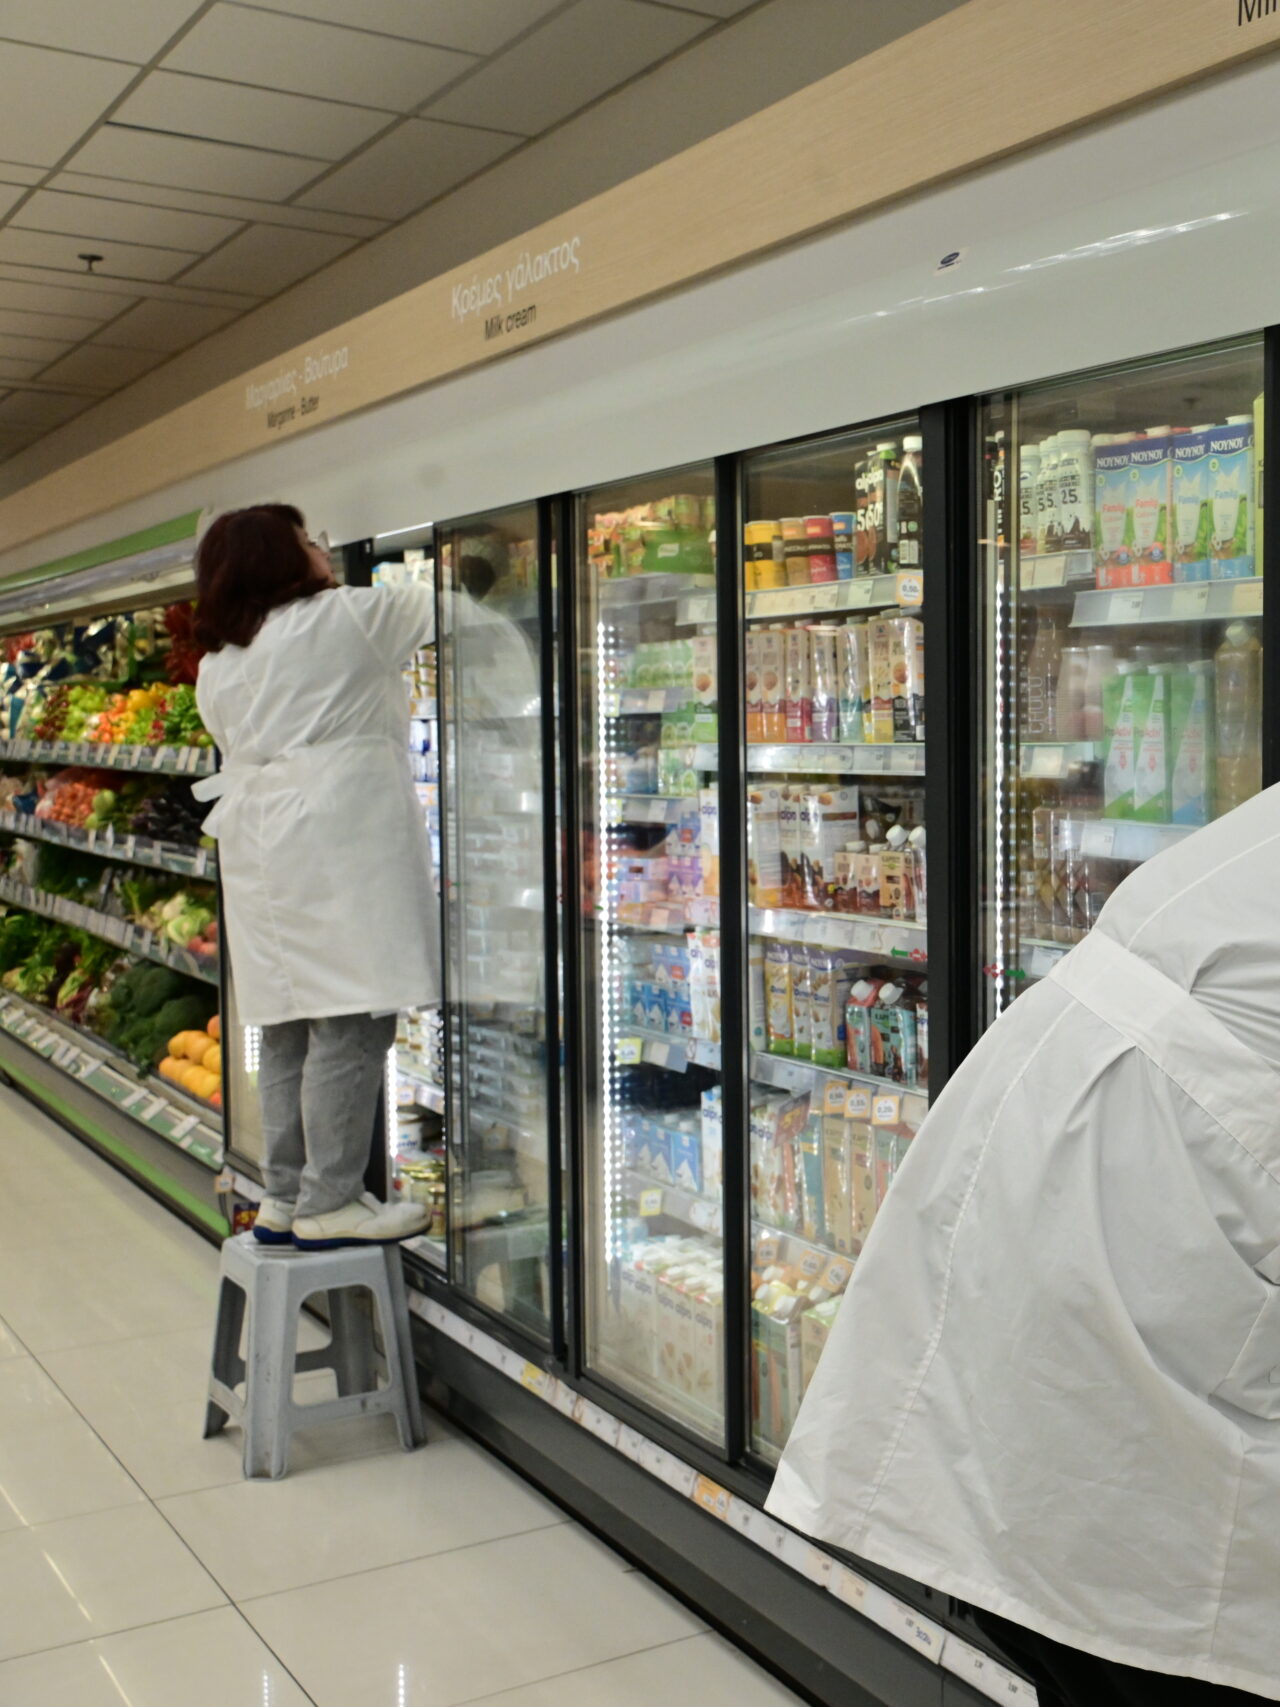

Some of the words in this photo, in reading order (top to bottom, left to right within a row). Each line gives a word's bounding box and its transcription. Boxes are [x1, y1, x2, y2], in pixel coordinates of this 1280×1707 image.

[451, 274, 502, 323] Κρέμες
[506, 236, 581, 302] γάλακτος
[484, 315, 504, 340] Milk
[505, 304, 537, 333] cream
[1175, 444, 1205, 458] NOYNOY
[1210, 437, 1244, 451] NOYNOY
[1131, 448, 1164, 462] NOYNOY
